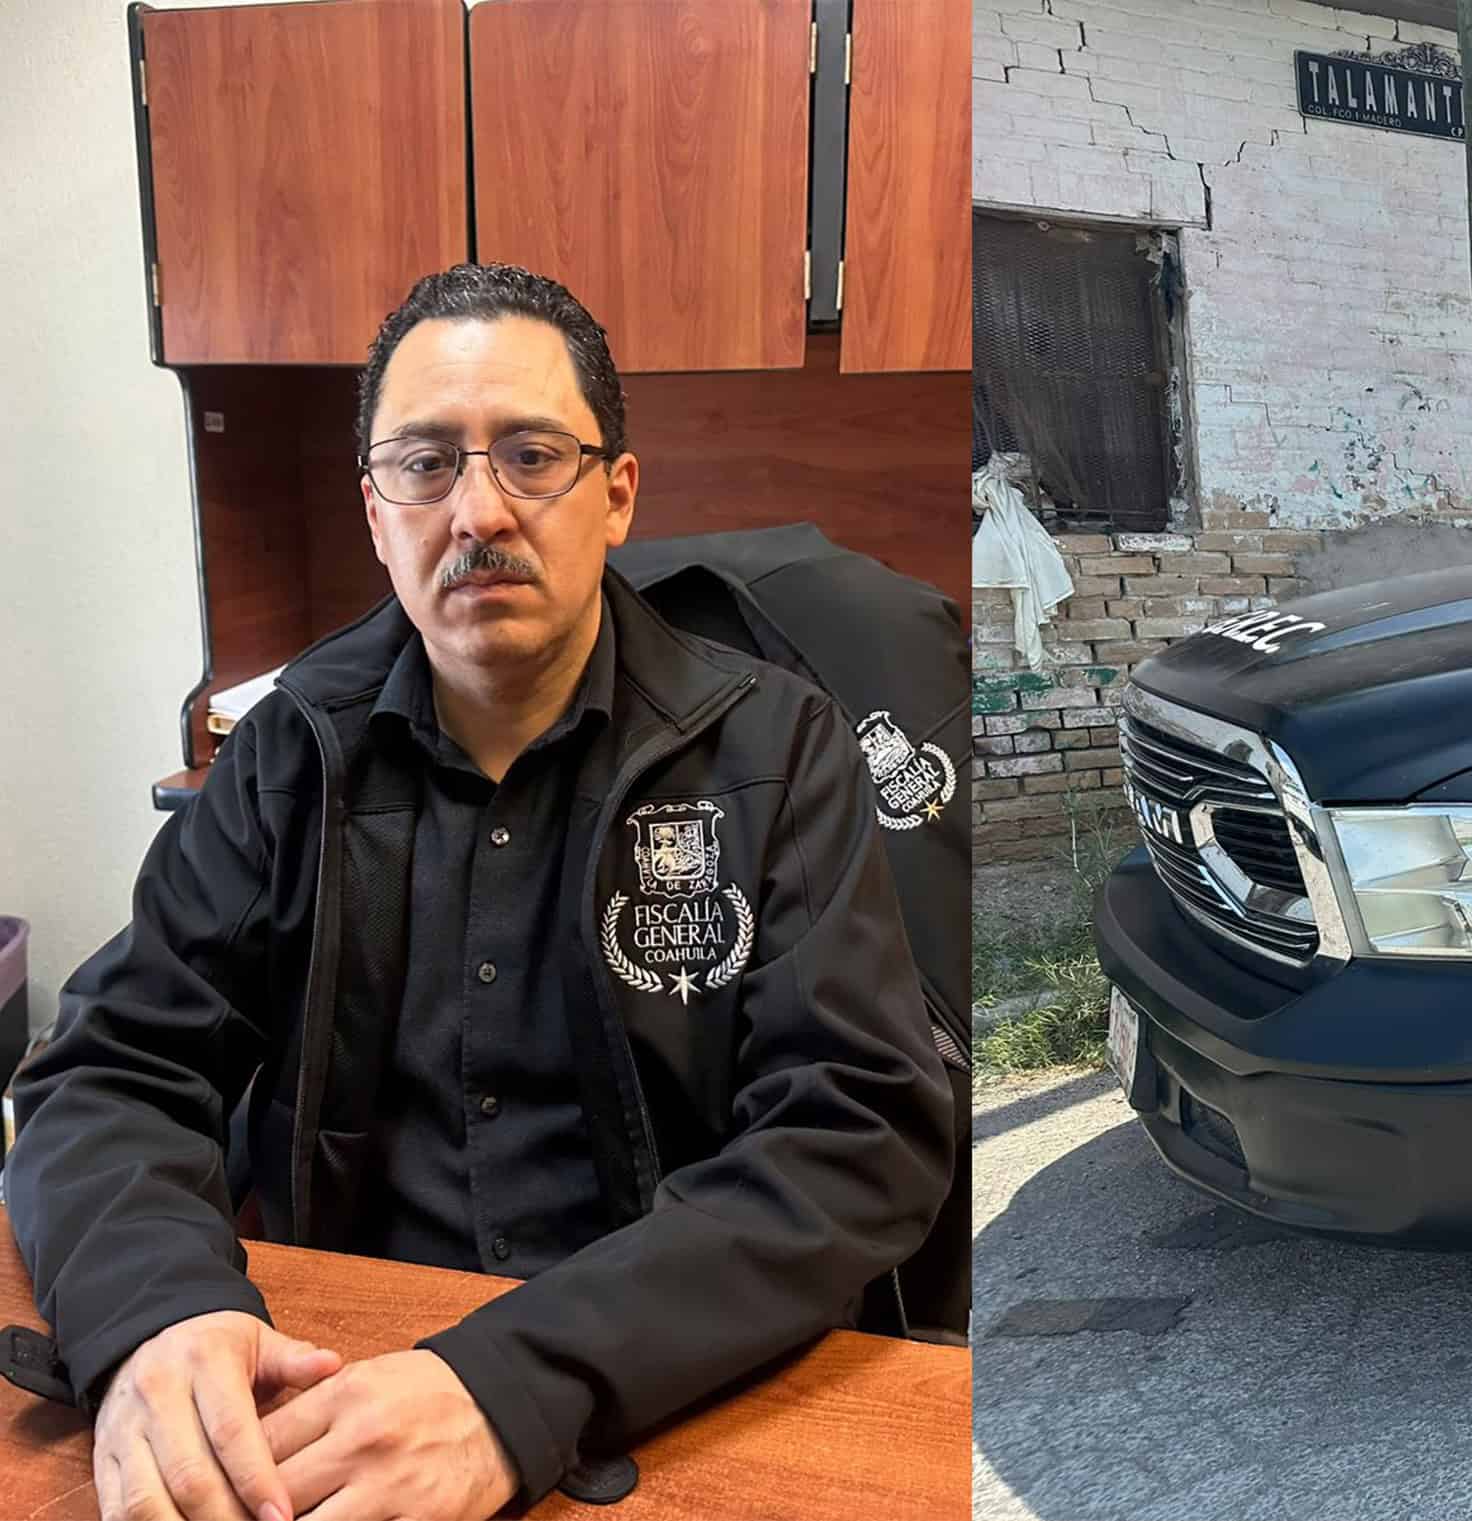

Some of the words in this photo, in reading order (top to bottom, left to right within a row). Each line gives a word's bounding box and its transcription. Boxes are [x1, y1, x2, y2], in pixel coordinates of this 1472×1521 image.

[1308, 61, 1465, 126] TALAMANT
[1362, 112, 1402, 127] MADERO
[887, 765, 941, 809] GENERAL
[666, 881, 681, 890] DE
[634, 897, 724, 927] FISCALÍA
[634, 923, 725, 948] GENERAL
[644, 947, 717, 963] COAHUILA
